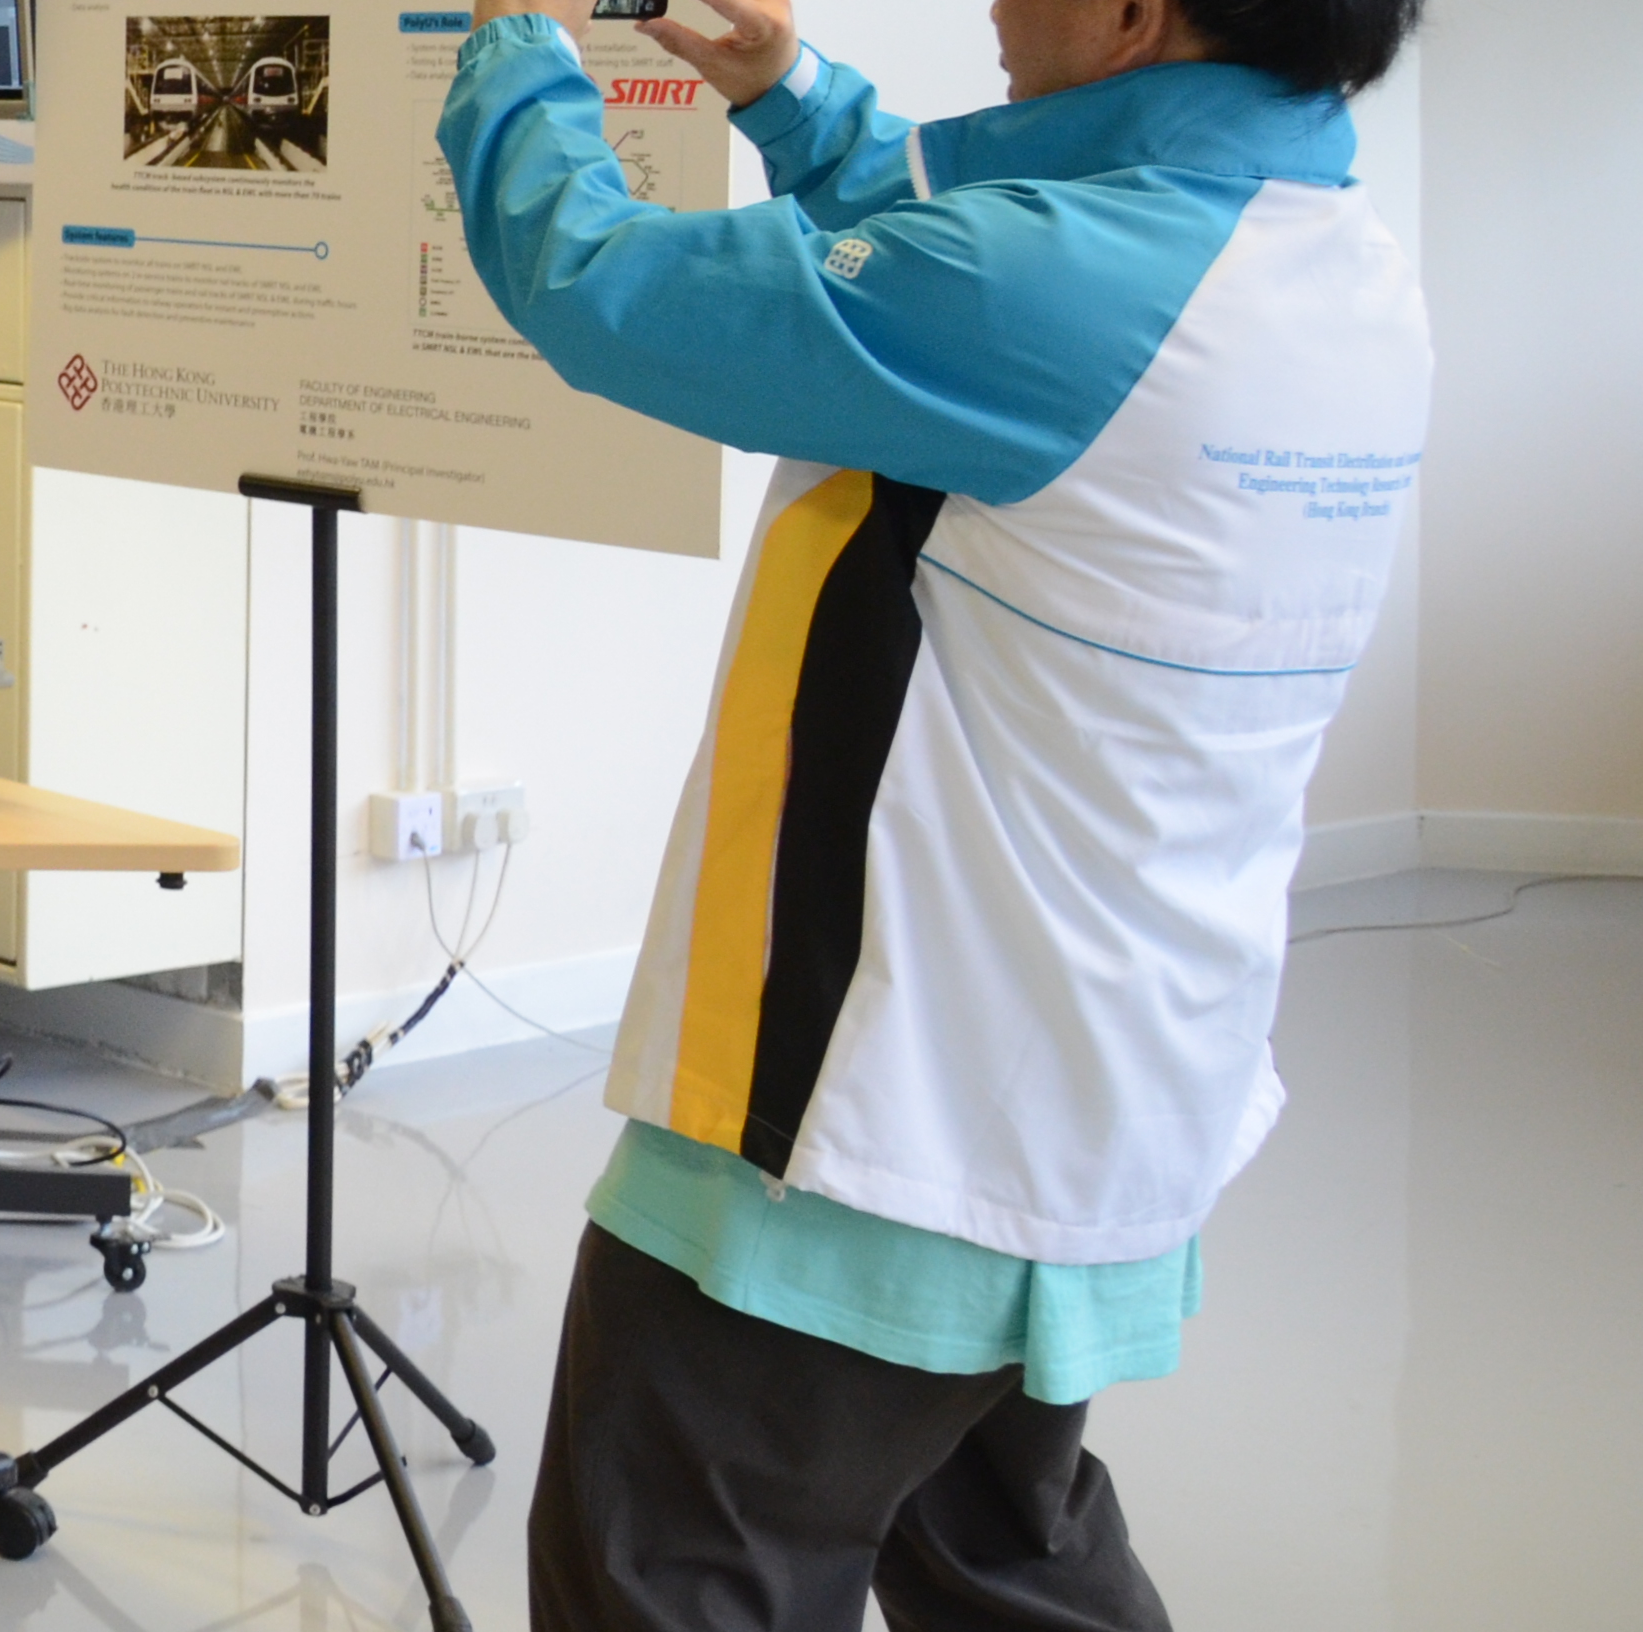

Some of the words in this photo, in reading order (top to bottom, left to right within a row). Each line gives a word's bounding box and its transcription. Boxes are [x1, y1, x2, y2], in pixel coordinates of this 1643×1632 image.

[404, 17, 439, 29] PolyU's
[441, 17, 463, 27] Role
[605, 79, 705, 105] SMRT
[65, 230, 93, 242] System
[95, 231, 129, 242] features
[102, 360, 129, 376] THE
[131, 363, 173, 381] HONG
[175, 368, 215, 386] KONG
[101, 379, 194, 402] POLYTECHNIC
[196, 389, 279, 412] UNIVERSITY
[300, 379, 343, 394] FACULTY
[345, 384, 360, 396] OF
[362, 385, 436, 404] ENGINEERING
[300, 395, 366, 412] DEPARTMENT
[368, 402, 384, 414] OF
[386, 403, 451, 421] ELECTRICAL
[453, 410, 531, 430] ENGINEERING
[1199, 444, 1259, 466] National
[1265, 448, 1291, 468] Rail
[1295, 451, 1334, 469] Transit
[1239, 473, 1317, 496] Engineering
